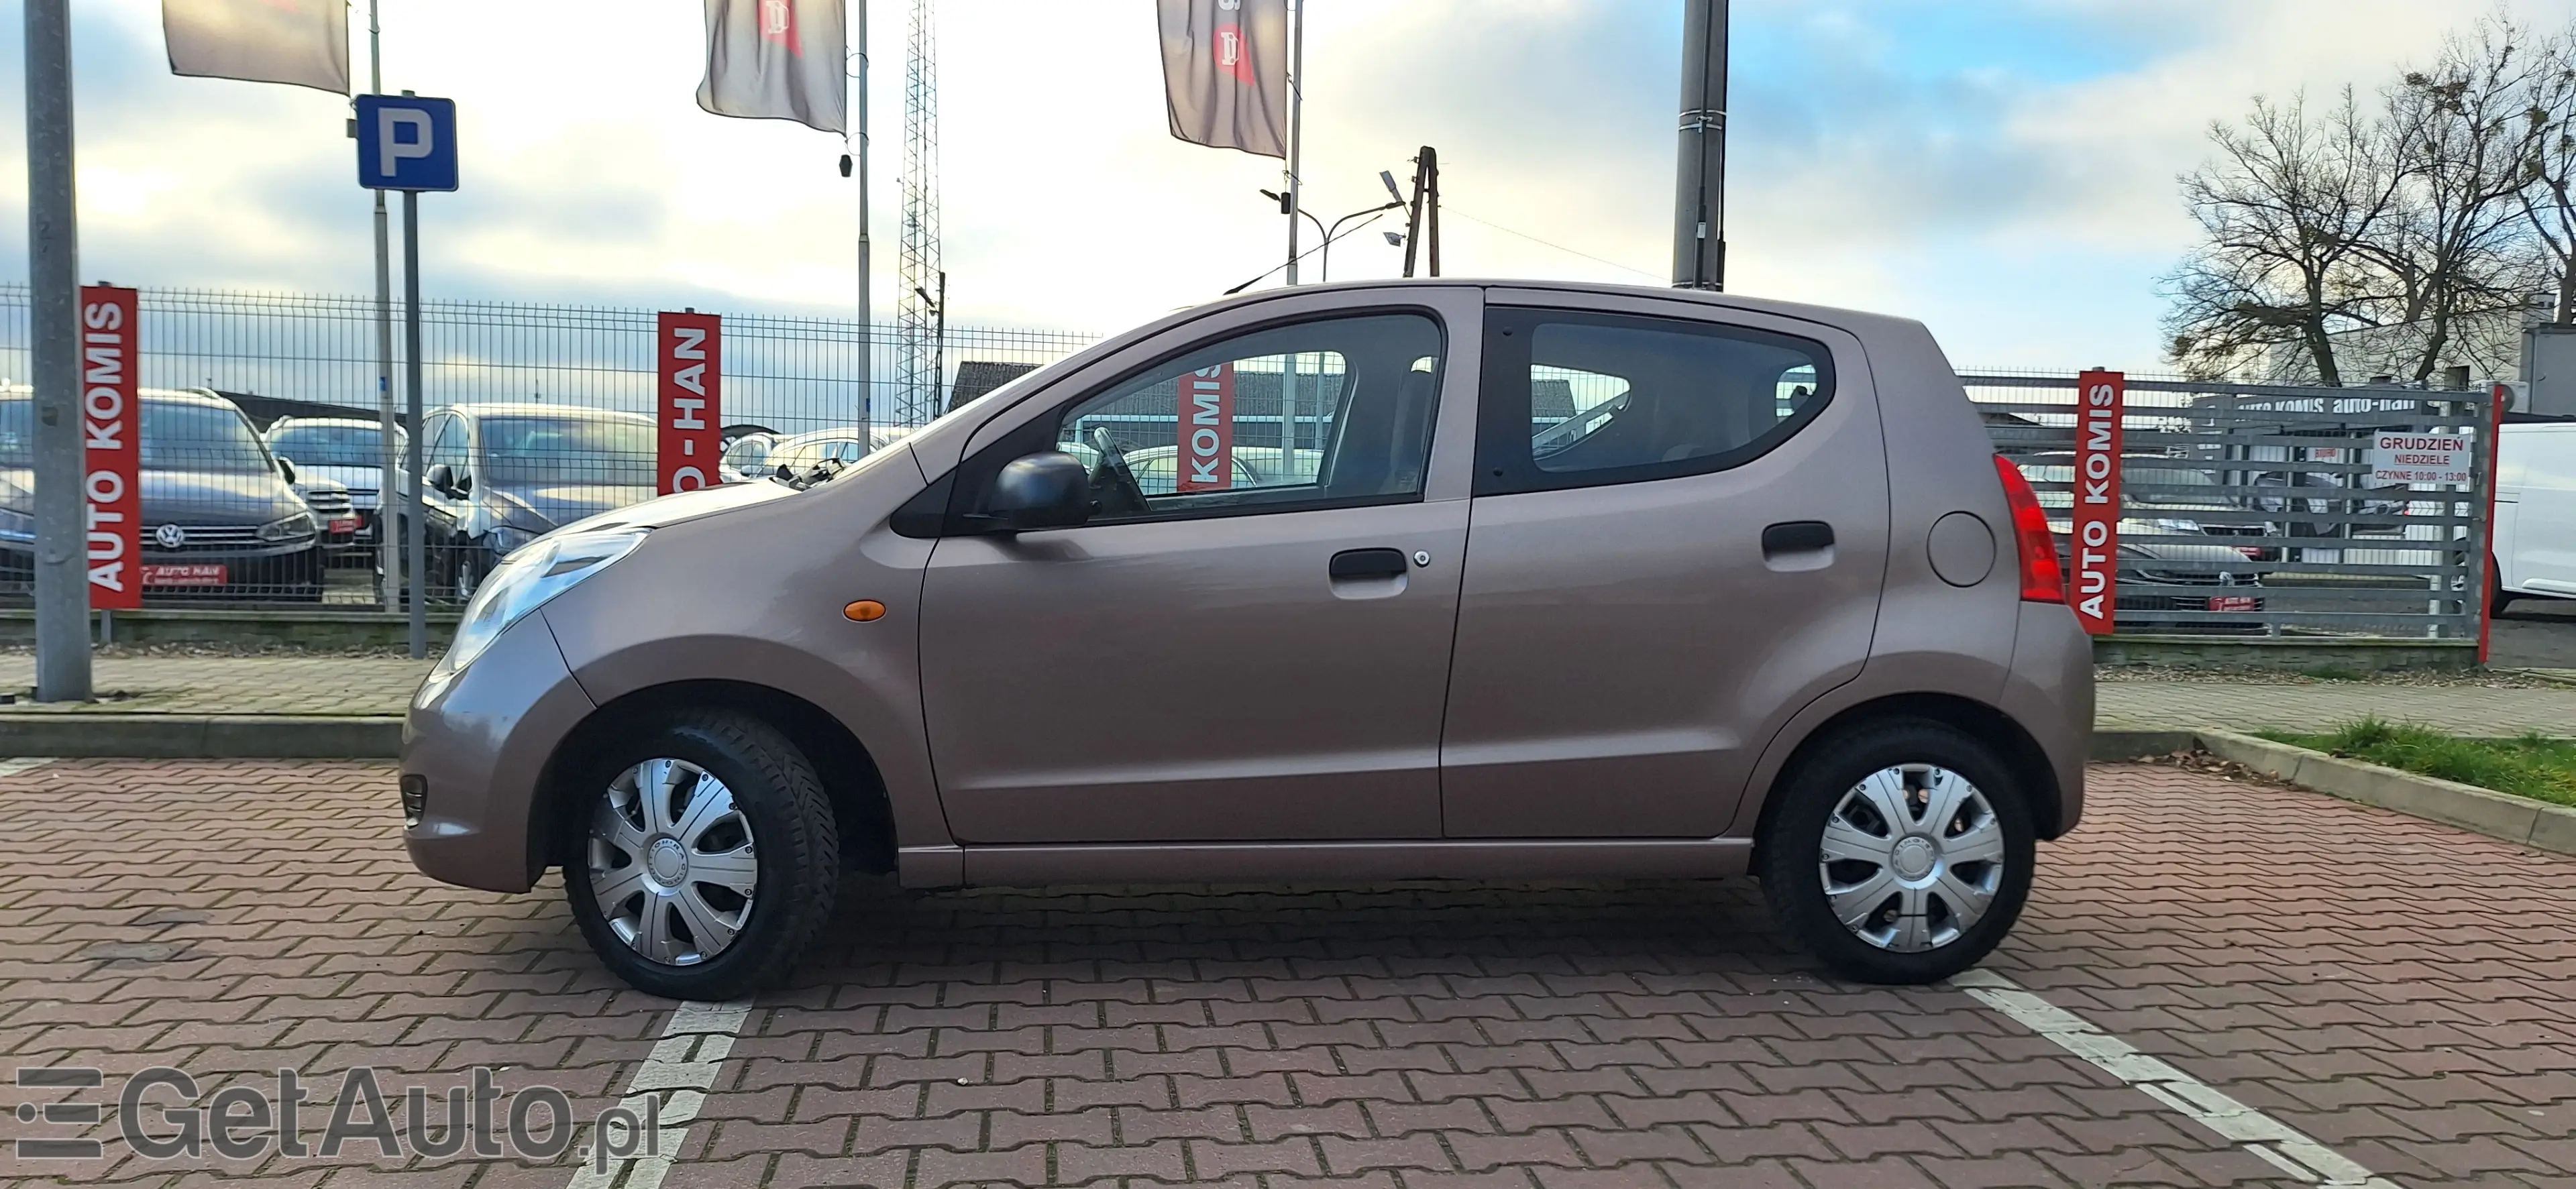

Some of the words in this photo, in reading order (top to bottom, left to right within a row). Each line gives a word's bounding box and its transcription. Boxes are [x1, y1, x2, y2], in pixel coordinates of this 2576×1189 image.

[378, 107, 433, 176] P
[85, 301, 123, 450] KOMIS
[2085, 384, 2114, 504] KOMIS
[2375, 470, 2412, 481] CZYNNE
[2415, 471, 2436, 482] 10:00
[2445, 472, 2467, 482] 13:00
[2380, 436, 2464, 451] GRUDZIEŃ
[2394, 454, 2451, 465] NIEDZIELE
[87, 471, 124, 592] AUTO
[2080, 520, 2108, 619] AUTO
